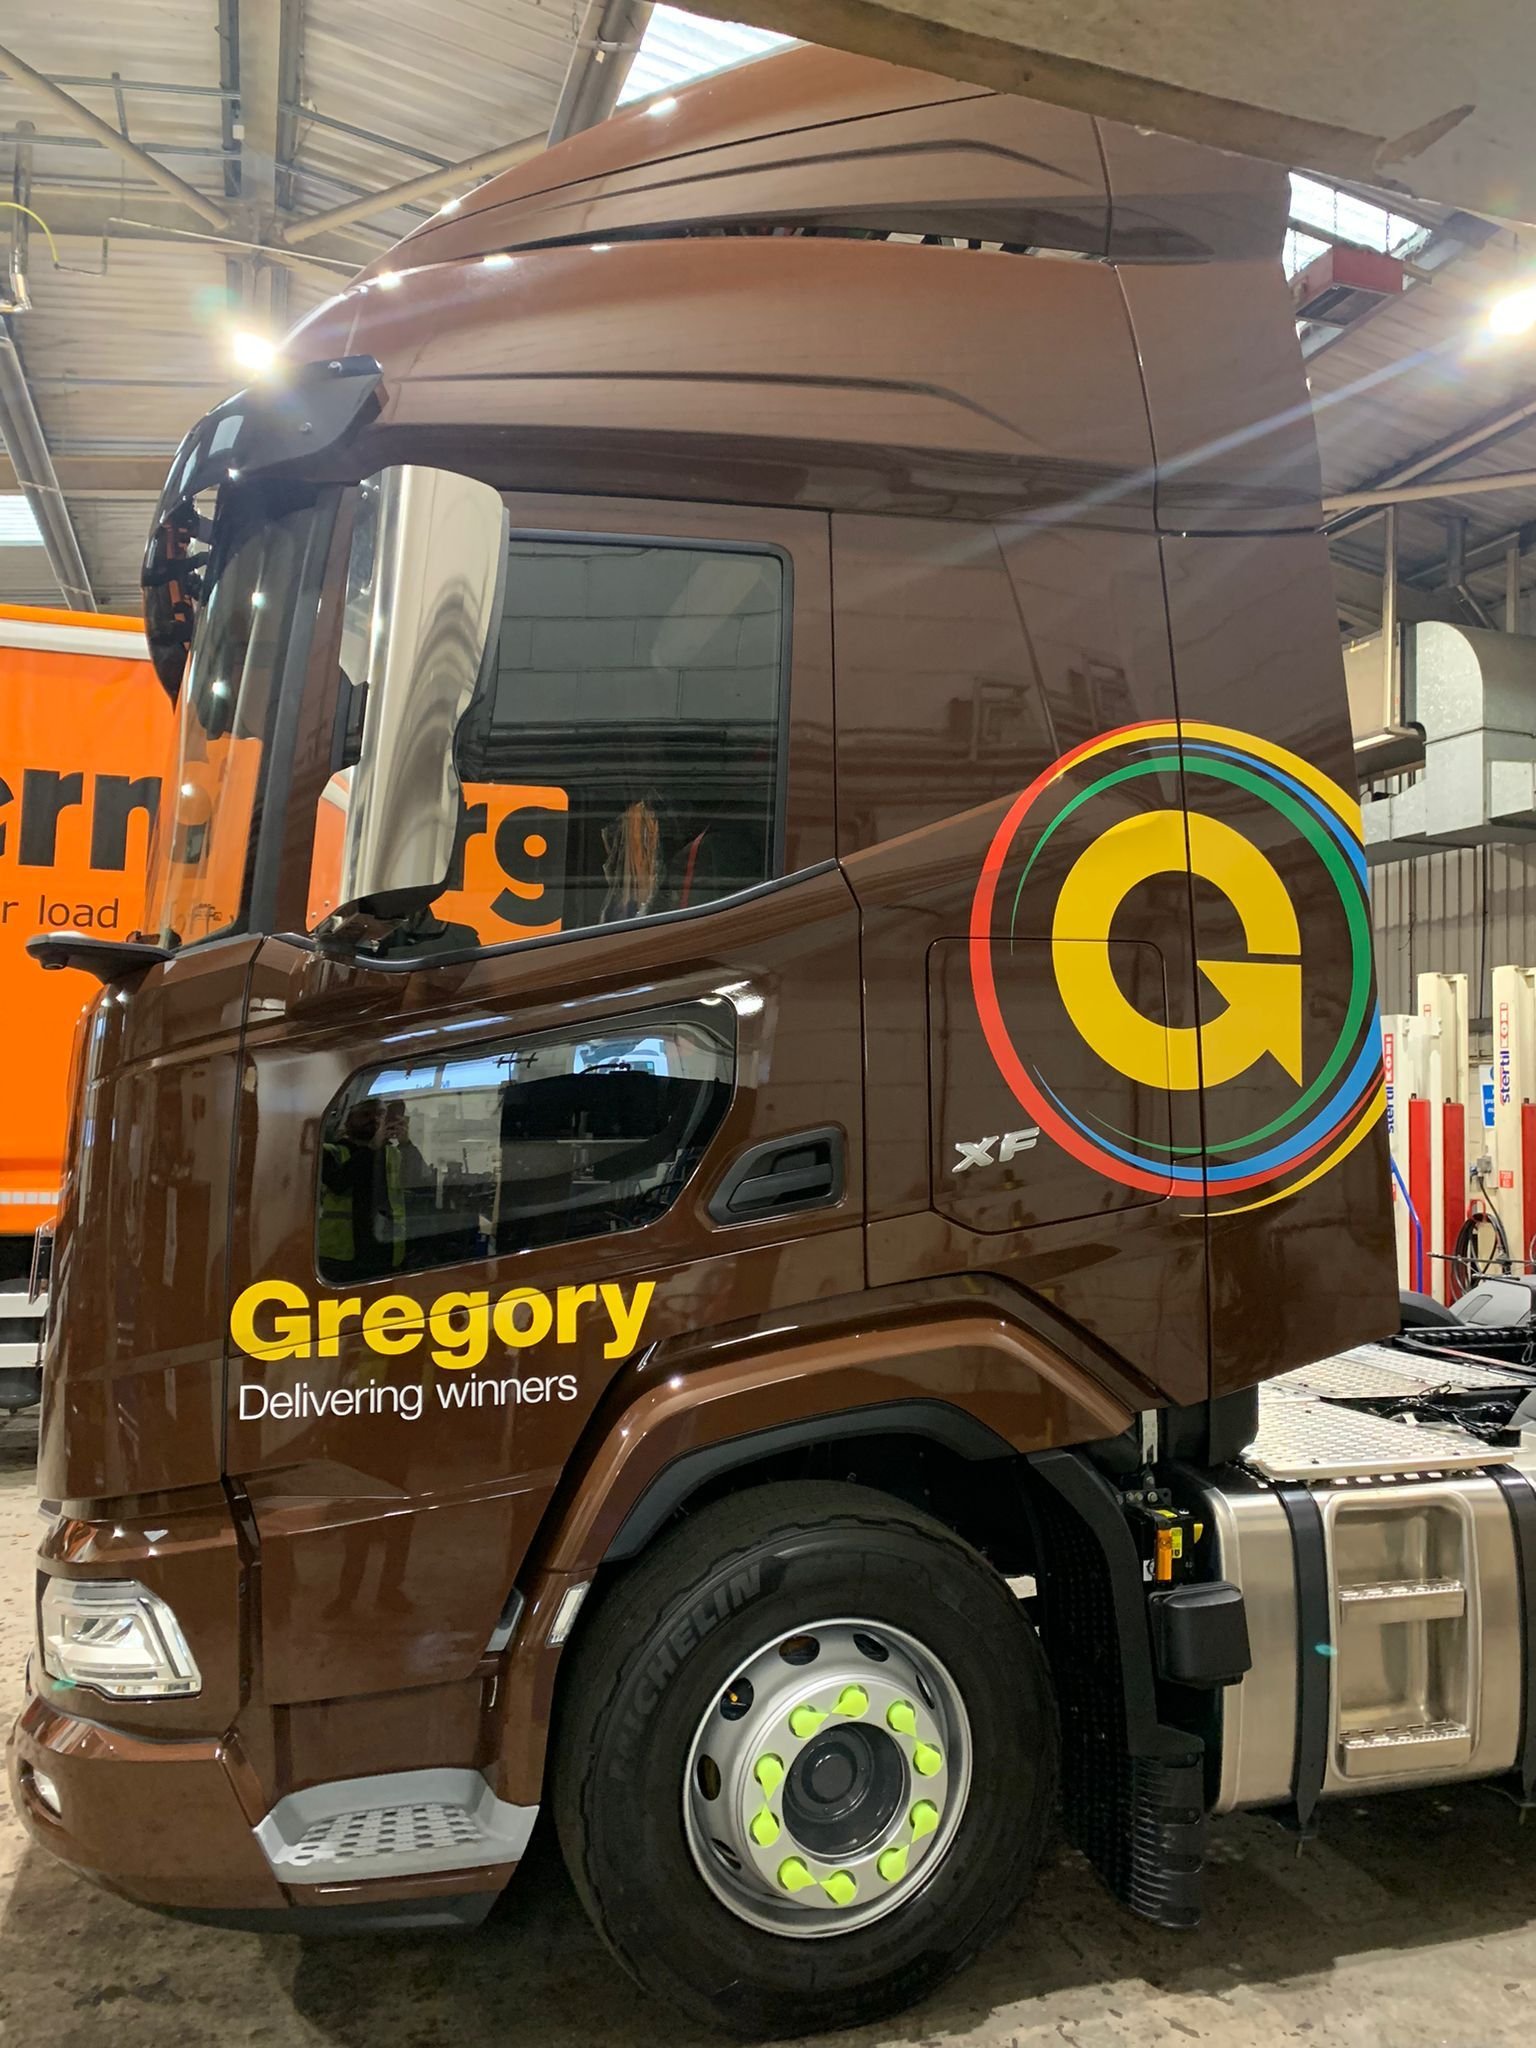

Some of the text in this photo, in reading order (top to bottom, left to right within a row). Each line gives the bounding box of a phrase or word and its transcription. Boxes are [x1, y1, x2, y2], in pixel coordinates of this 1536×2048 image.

[39, 894, 119, 929] load
[1384, 1035, 1393, 1082] KONI
[952, 1127, 1040, 1173] XF
[230, 1280, 656, 1370] Gregory
[239, 1372, 578, 1421] Delivering winners
[609, 1564, 762, 1779] MICHELIN
